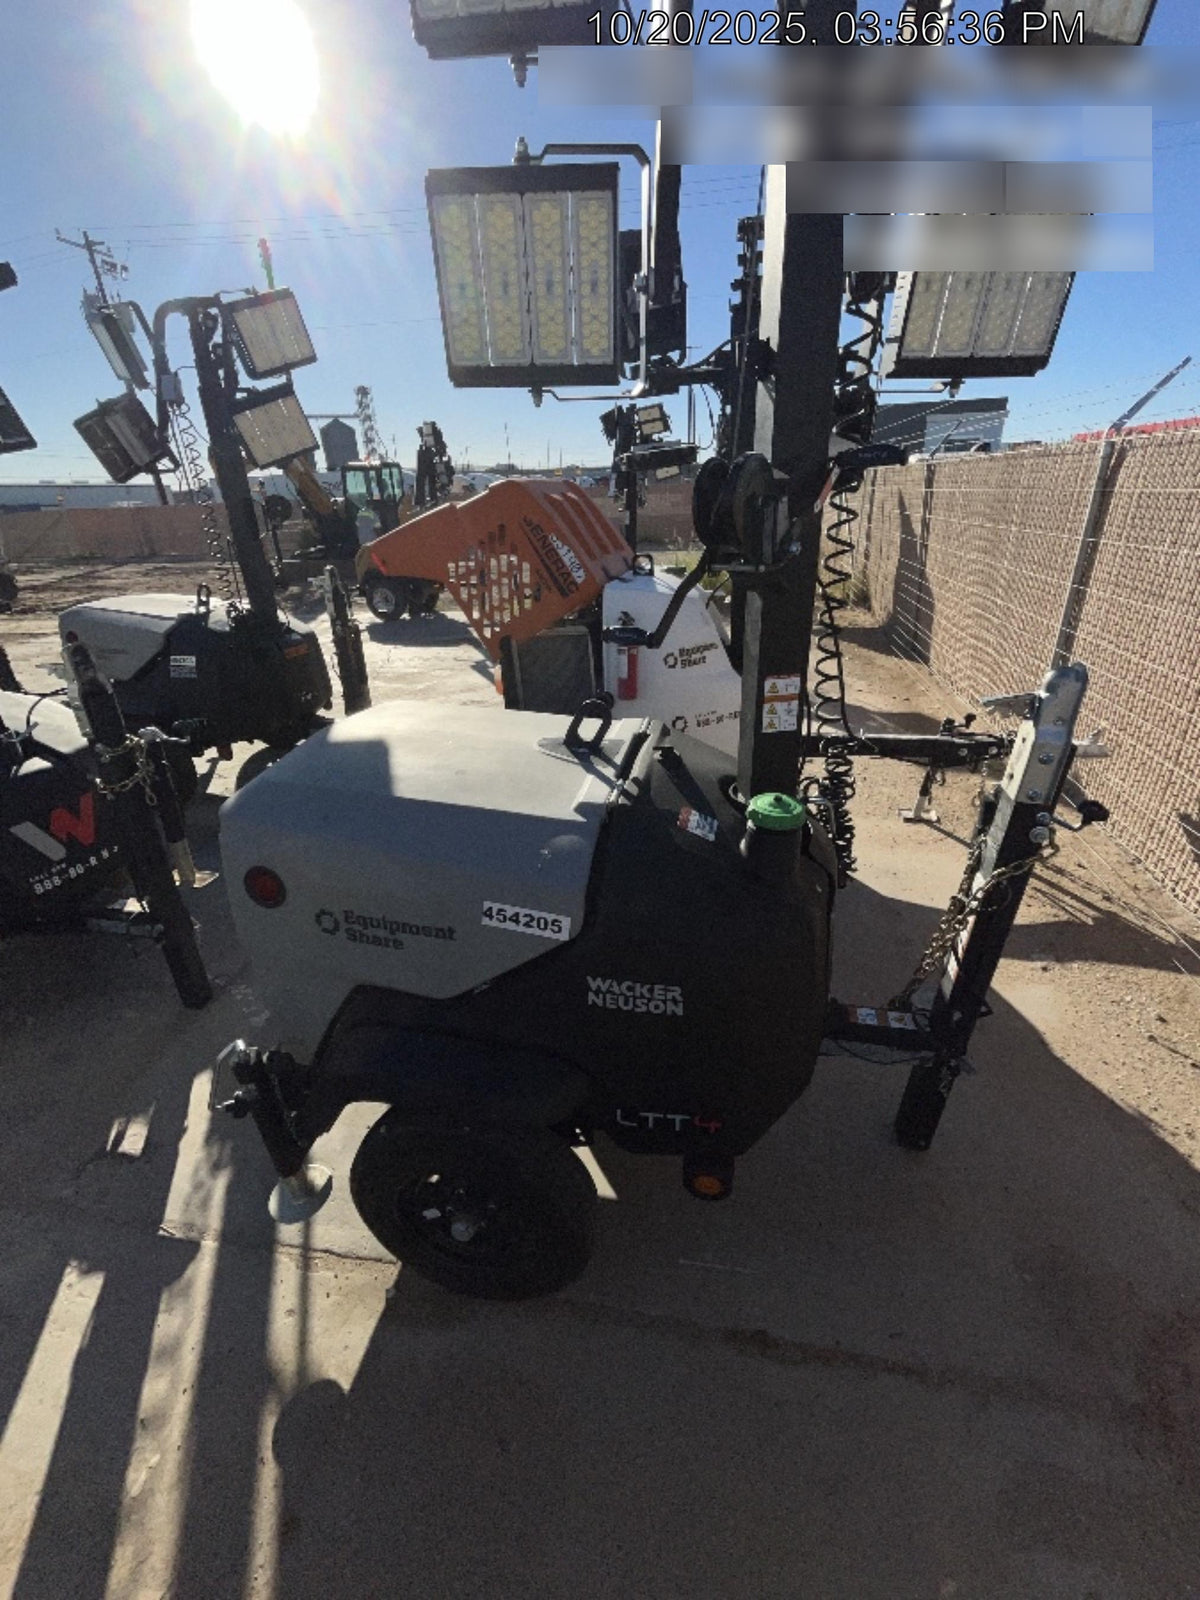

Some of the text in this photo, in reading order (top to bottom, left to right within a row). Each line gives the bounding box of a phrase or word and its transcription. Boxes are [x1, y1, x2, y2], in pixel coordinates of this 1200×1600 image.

[343, 909, 457, 942] Equipment
[482, 905, 563, 935] 454205
[345, 927, 405, 950] Share
[586, 975, 684, 1002] WACKER
[587, 991, 684, 1017] NEUSON
